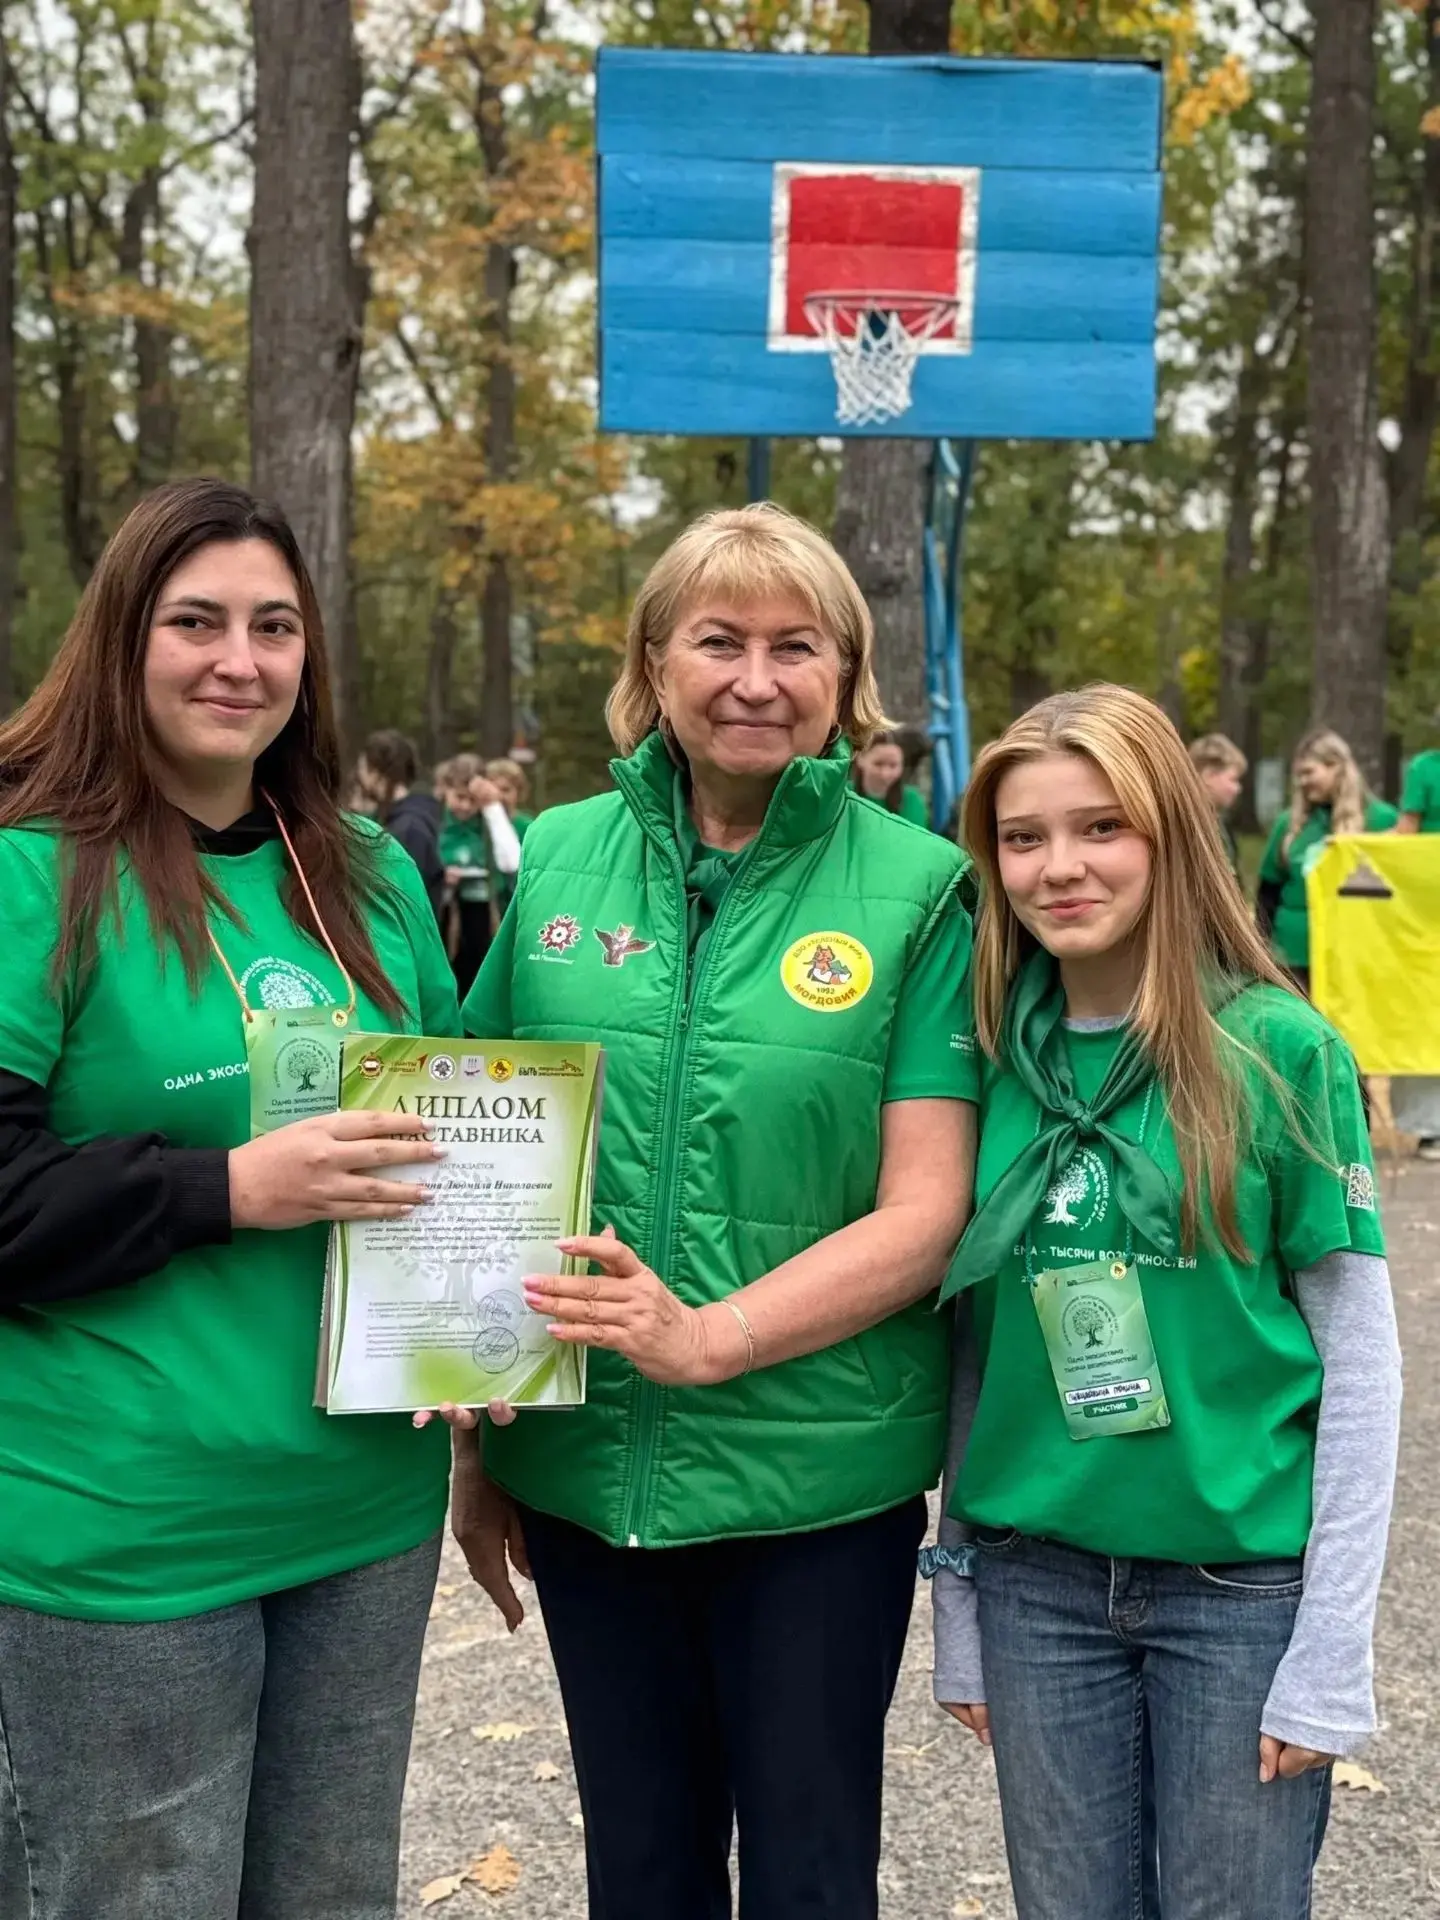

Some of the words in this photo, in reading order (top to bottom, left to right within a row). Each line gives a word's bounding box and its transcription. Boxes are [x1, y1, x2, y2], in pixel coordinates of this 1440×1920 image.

[793, 983, 857, 1006] МОРДОВИЯ
[164, 1071, 204, 1091] ОДНА
[1077, 1145, 1110, 1198] КОЛОГИЧЕСКИЙ
[444, 1180, 491, 1191] Людмила
[494, 1180, 553, 1190] Николаевна
[1050, 1245, 1096, 1261] ТЫСЯЧИ
